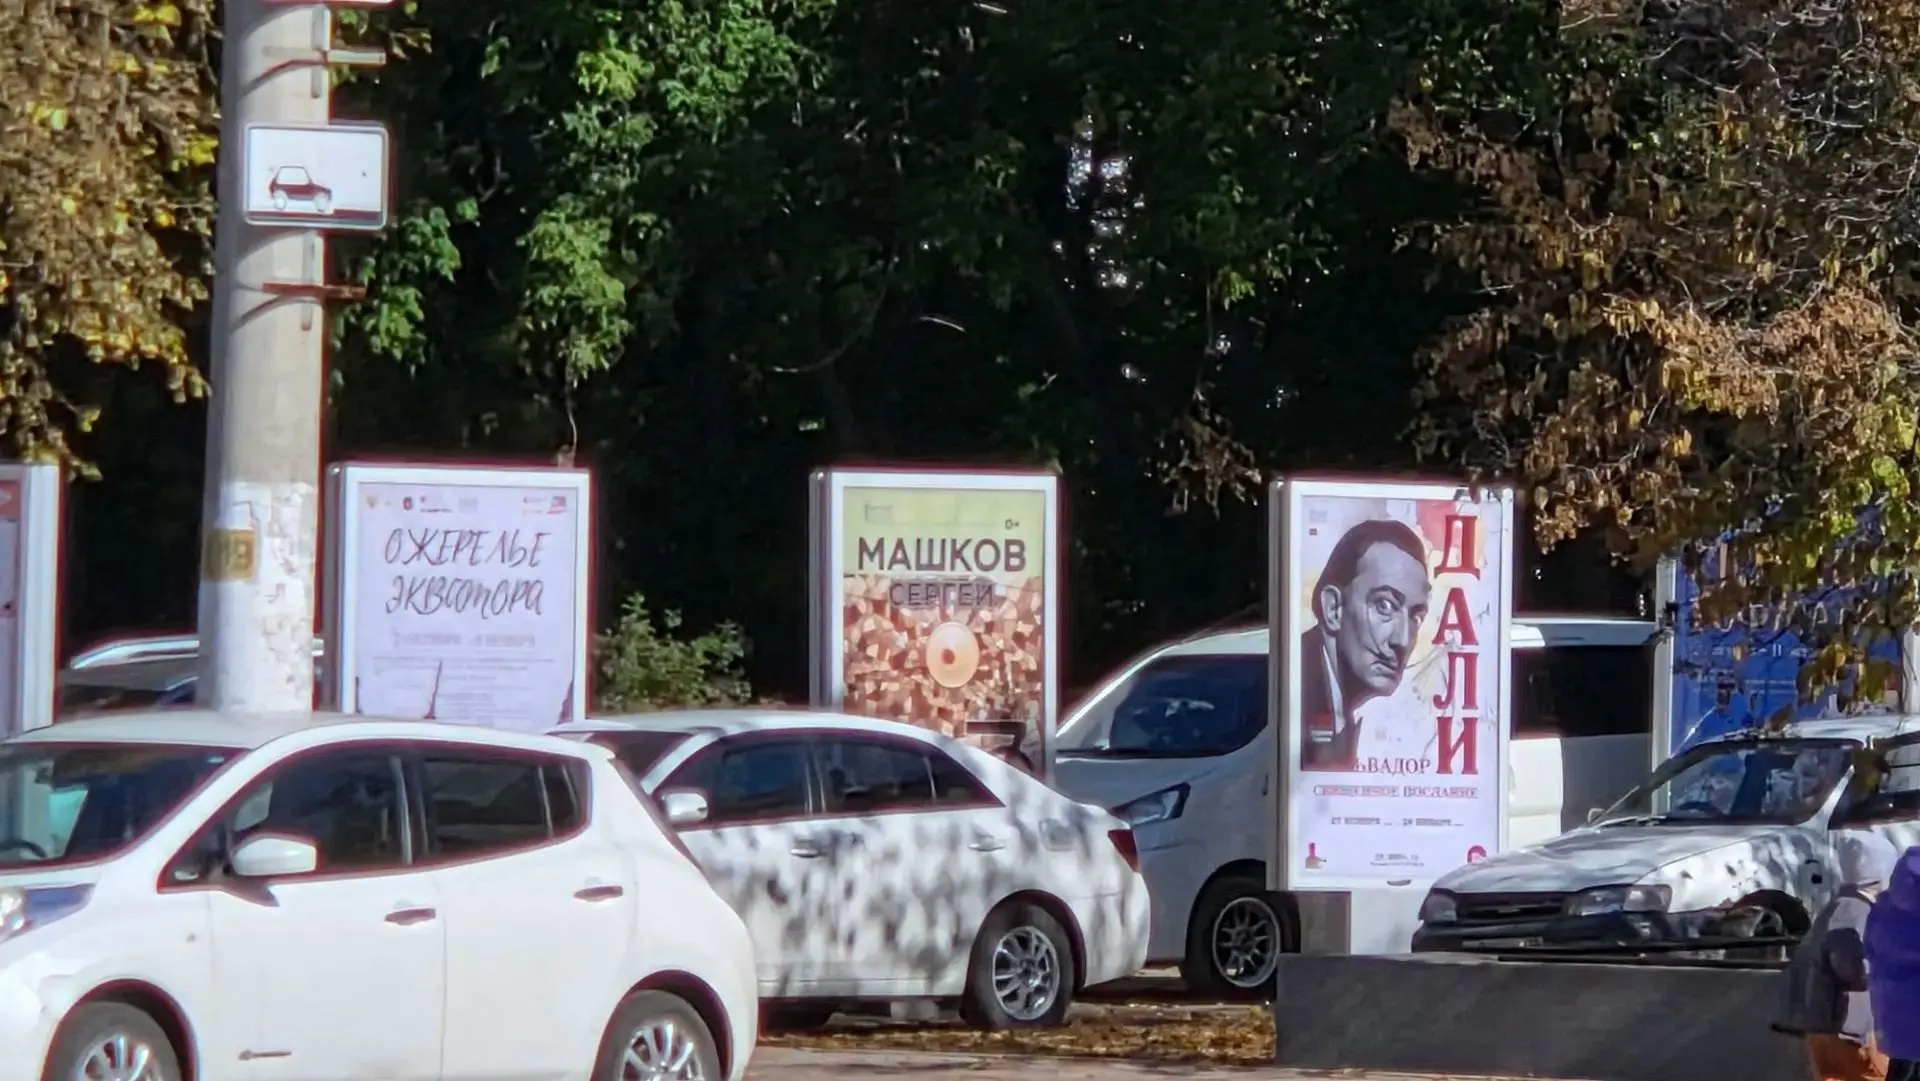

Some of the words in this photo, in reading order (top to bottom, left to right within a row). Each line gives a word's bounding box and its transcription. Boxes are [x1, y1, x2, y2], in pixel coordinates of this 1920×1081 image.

[384, 528, 552, 567] ОЖЕРЕЛЬЕ
[858, 536, 1027, 572] МАШКОВ
[1432, 515, 1480, 775] ДАЛИ
